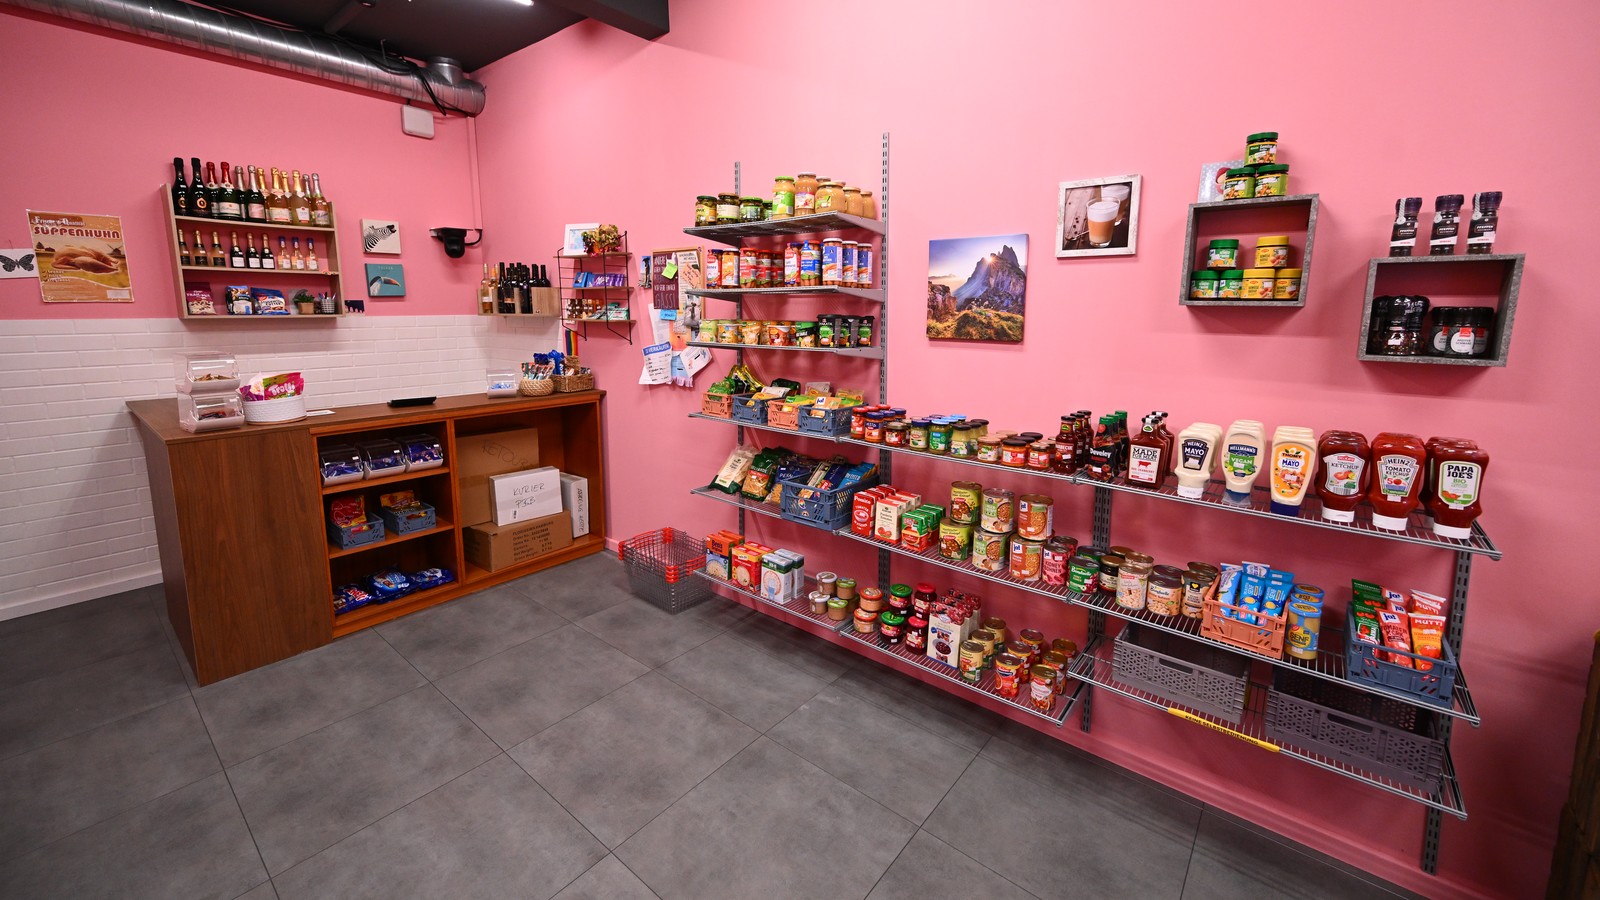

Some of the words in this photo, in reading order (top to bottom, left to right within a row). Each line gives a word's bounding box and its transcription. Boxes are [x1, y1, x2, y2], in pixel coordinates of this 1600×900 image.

[34, 226, 120, 239] SUPPENHUHN
[268, 382, 296, 396] Trolli
[1186, 441, 1204, 449] HEINZ
[1229, 445, 1257, 454] HELLMANN'S
[1090, 447, 1112, 459] Develey
[1132, 447, 1158, 457] MADE
[1184, 447, 1205, 456] MAYO
[1230, 457, 1253, 465] VEGAN
[1281, 459, 1300, 468] MAYO
[1387, 458, 1410, 467] HEINZ
[1331, 462, 1359, 470] KETCHUP
[1385, 465, 1411, 473] TOMATO
[1447, 464, 1474, 474] PAPA
[1385, 470, 1410, 478] KETCHUP
[1447, 470, 1473, 480] JOE'S
[1045, 560, 1062, 568] KIDNEY
[1388, 591, 1401, 599] ja!
[1415, 601, 1440, 614] MUTTI
[1383, 613, 1396, 621] ja!
[1414, 618, 1443, 627] MUTTI
[1290, 632, 1309, 643] SENF
[1185, 715, 1202, 725] KEINE
[1202, 720, 1259, 745] SELBSTBEDIENUNG
